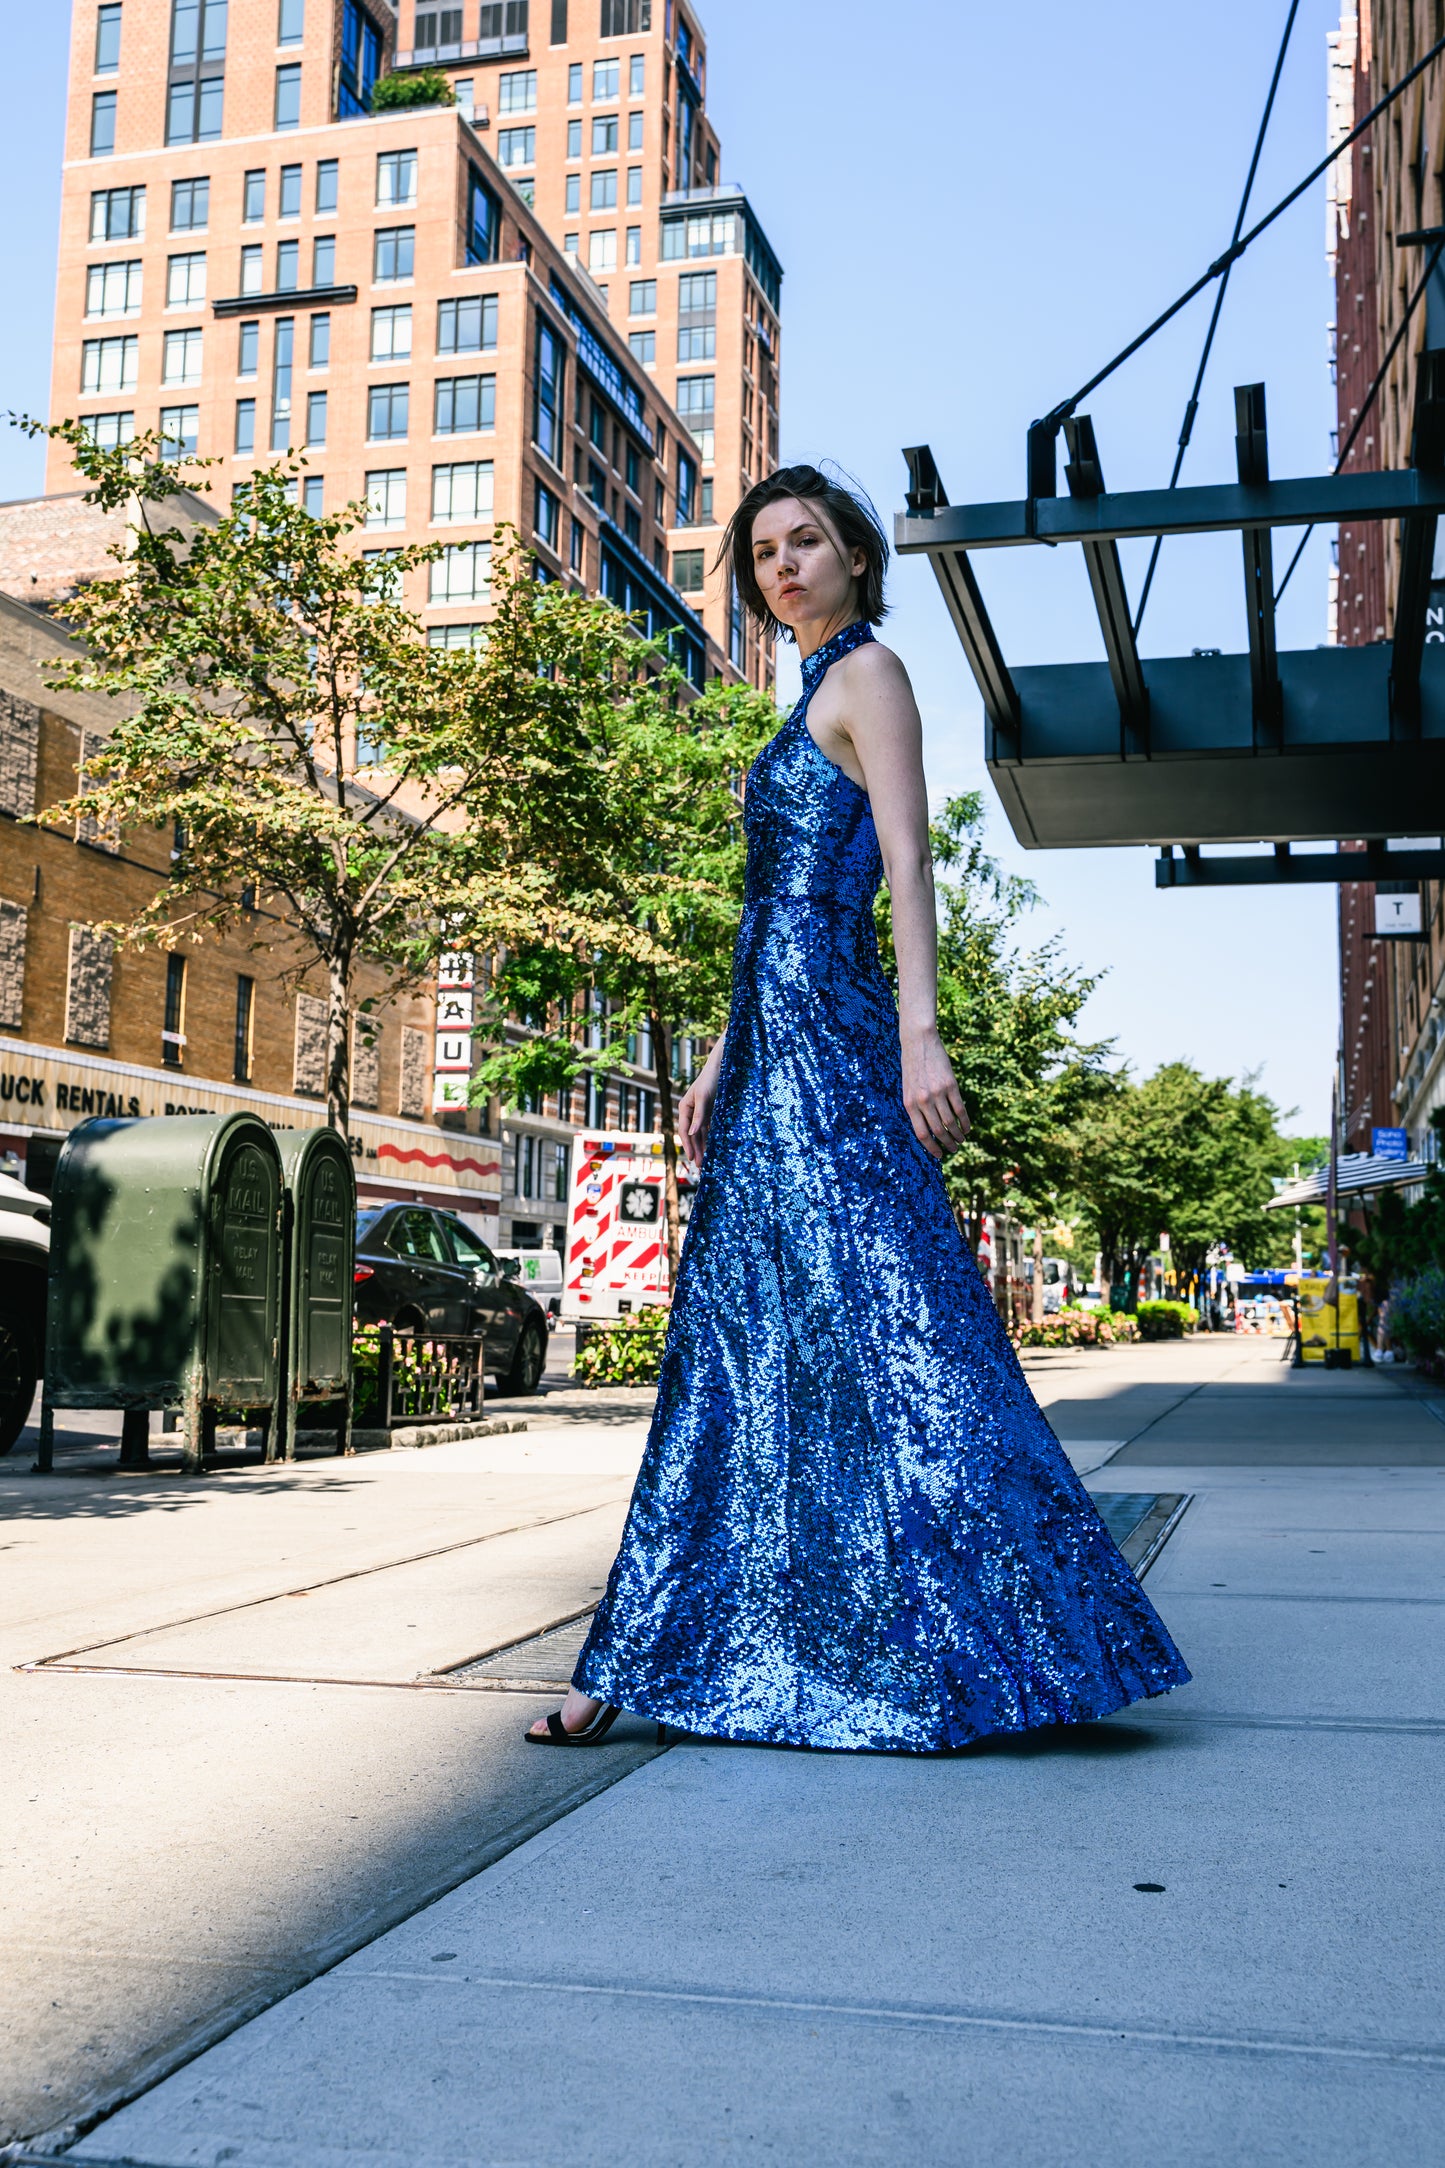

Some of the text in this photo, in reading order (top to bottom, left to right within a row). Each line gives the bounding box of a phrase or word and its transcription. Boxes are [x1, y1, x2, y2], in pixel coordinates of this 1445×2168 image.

[1392, 901, 1404, 916] T
[56, 1083, 141, 1118] RENTALS
[230, 1187, 265, 1214] MAIL
[314, 1197, 342, 1222] MAIL
[624, 1272, 657, 1282] KEEP
